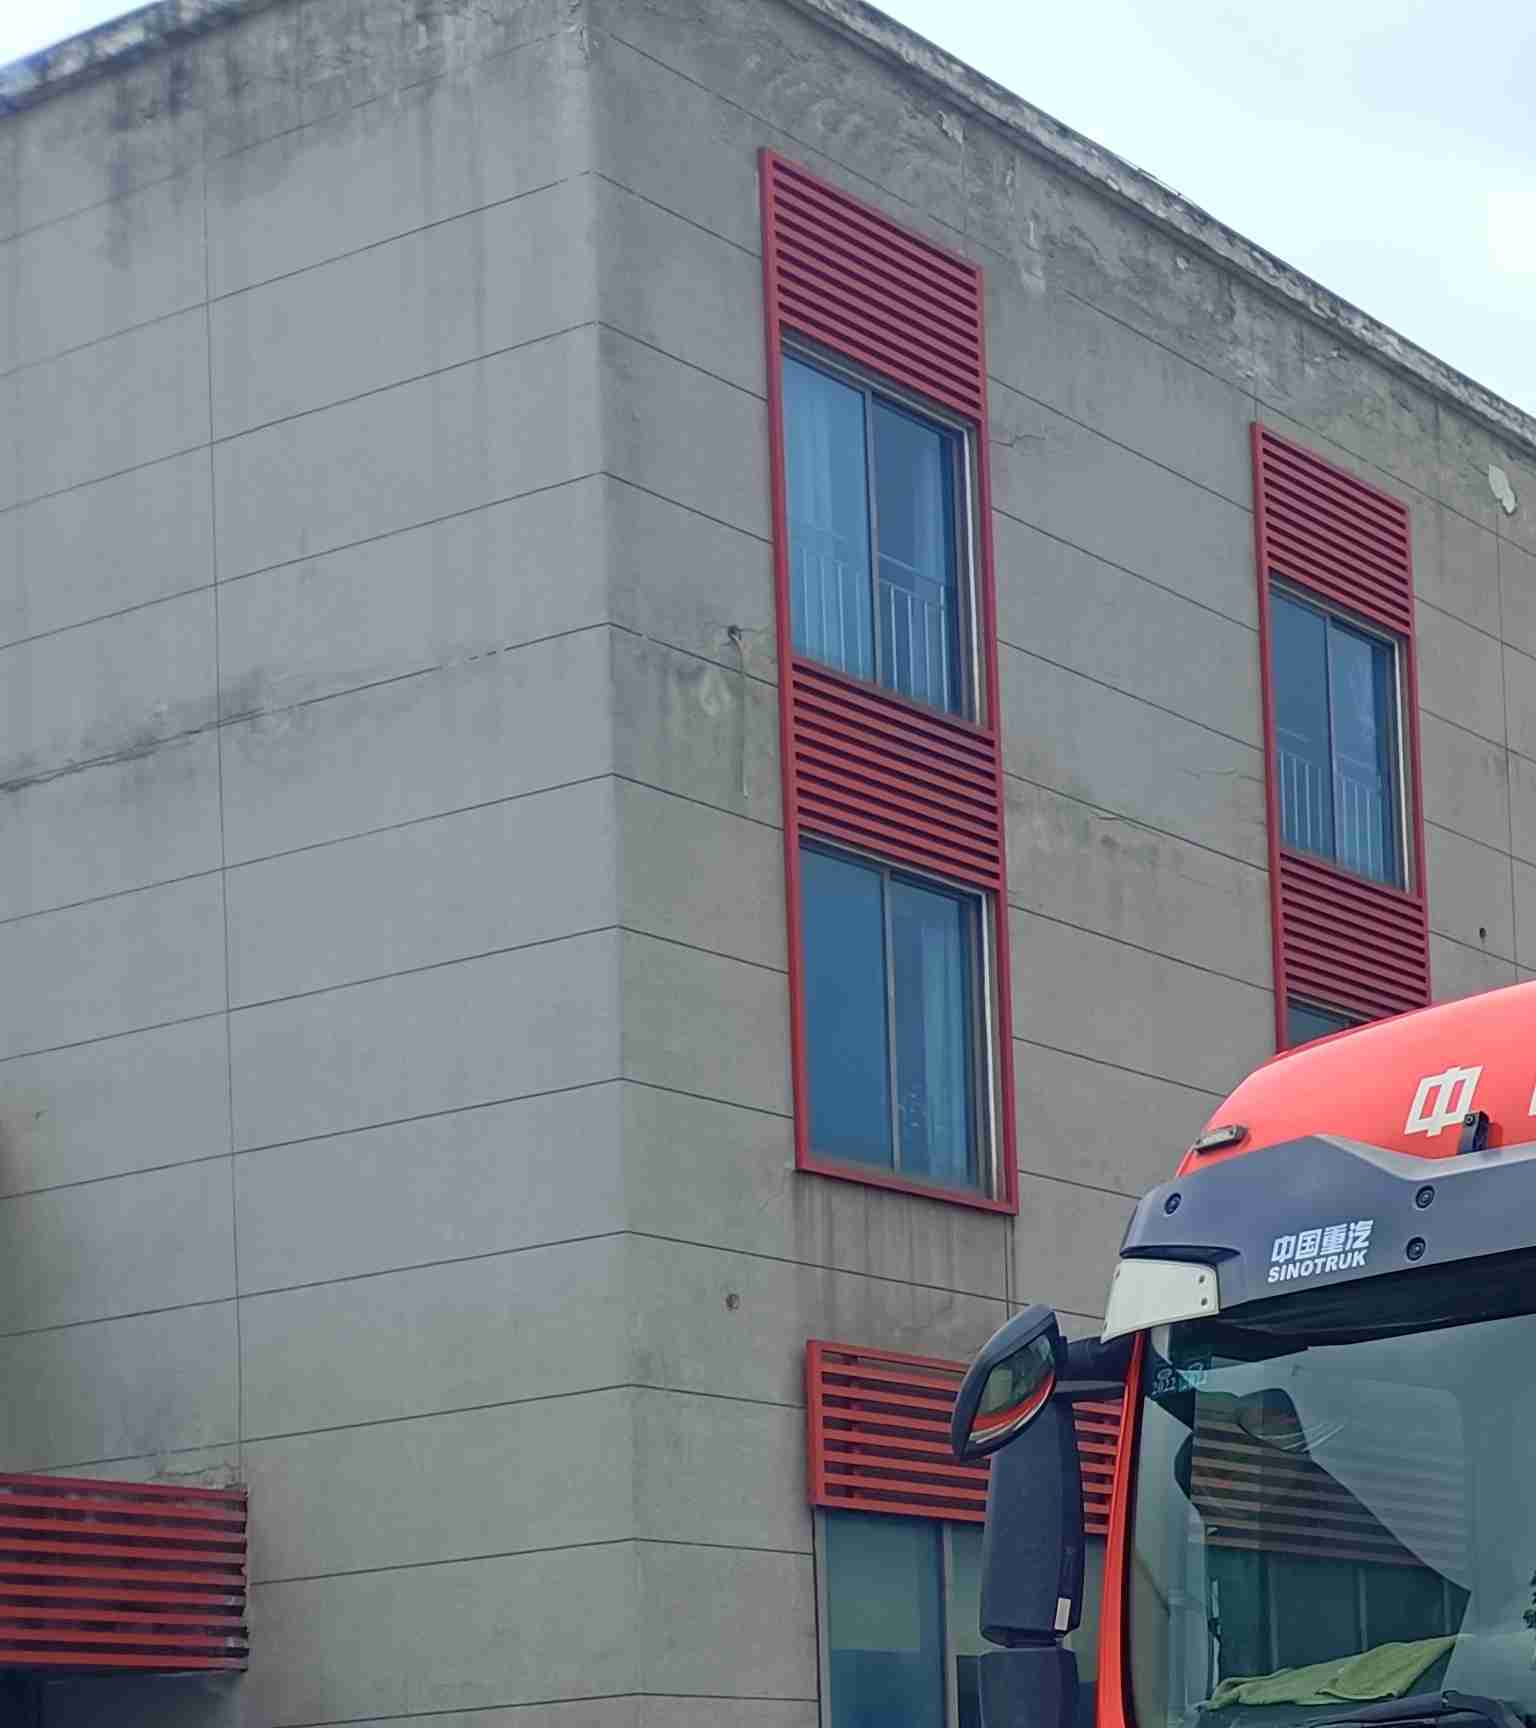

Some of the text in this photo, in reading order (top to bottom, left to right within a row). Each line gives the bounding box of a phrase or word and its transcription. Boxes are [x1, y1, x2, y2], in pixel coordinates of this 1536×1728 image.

[1271, 1219, 1374, 1263] 中国重汽
[1267, 1249, 1368, 1283] SINOTRUK
